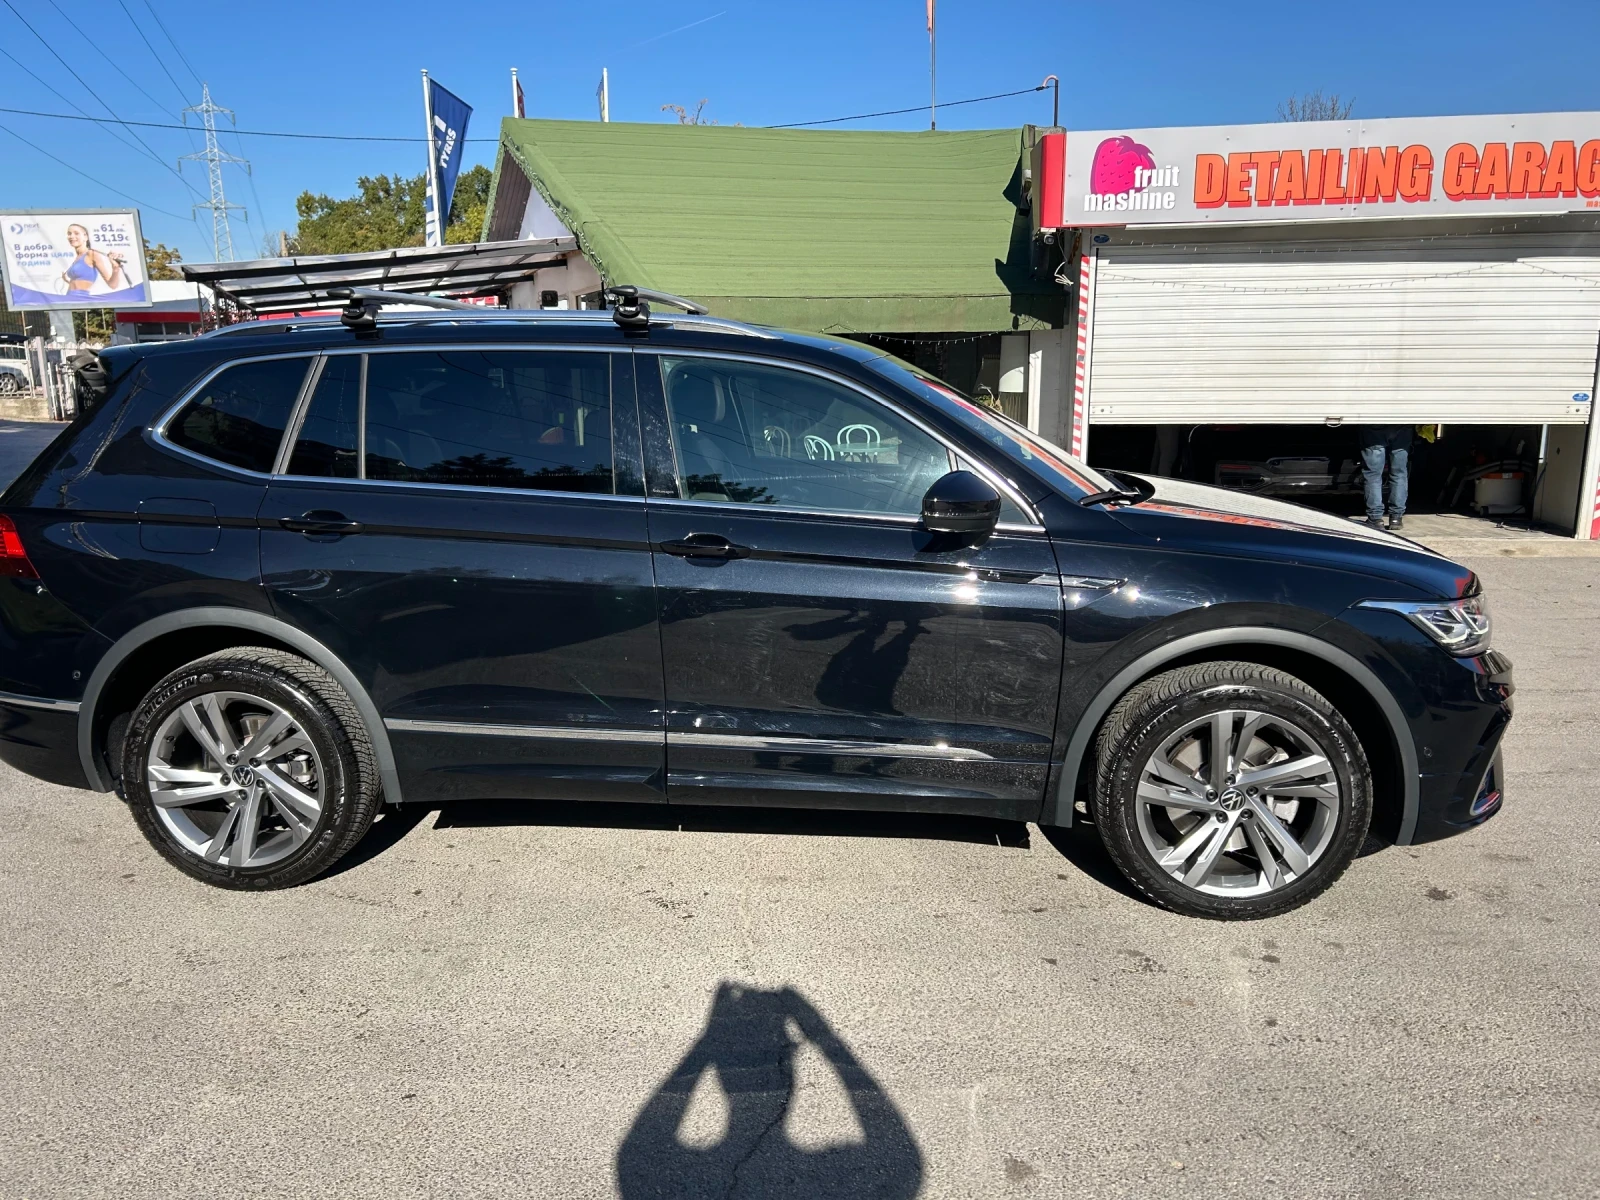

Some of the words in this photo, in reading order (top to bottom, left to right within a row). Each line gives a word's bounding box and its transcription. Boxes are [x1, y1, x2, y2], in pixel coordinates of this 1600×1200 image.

[439, 128, 457, 169] TYRES
[1134, 165, 1180, 188] fruit
[1194, 144, 1434, 208] DETAILING
[1083, 189, 1176, 212] mashine
[100, 224, 115, 232] 61
[15, 251, 48, 260] форма
[24, 243, 53, 251] добра
